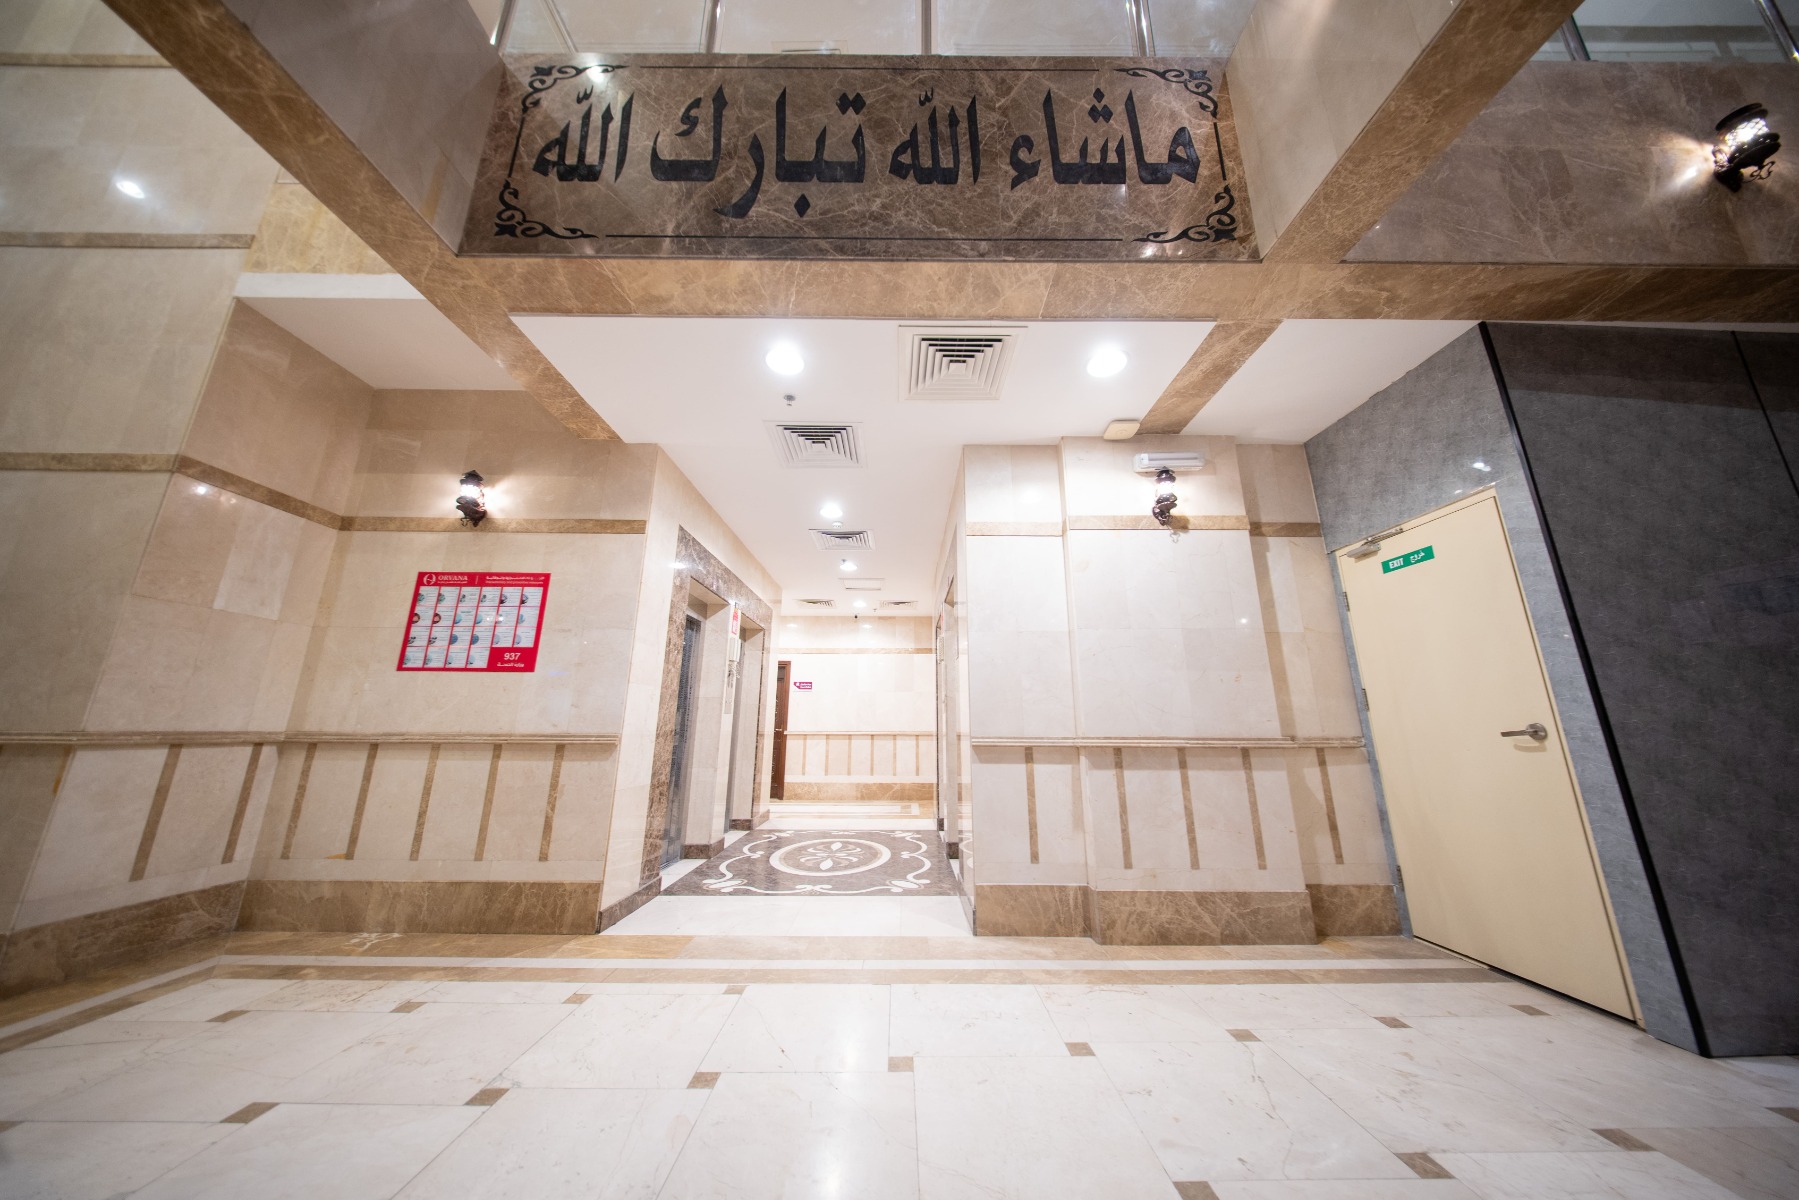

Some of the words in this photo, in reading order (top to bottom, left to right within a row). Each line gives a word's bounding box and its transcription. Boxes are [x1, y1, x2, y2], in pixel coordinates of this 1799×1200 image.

[650, 84, 867, 218] تبارك
[1410, 550, 1425, 563] خروج
[1389, 558, 1404, 569] EXIT
[503, 652, 521, 661] 937
